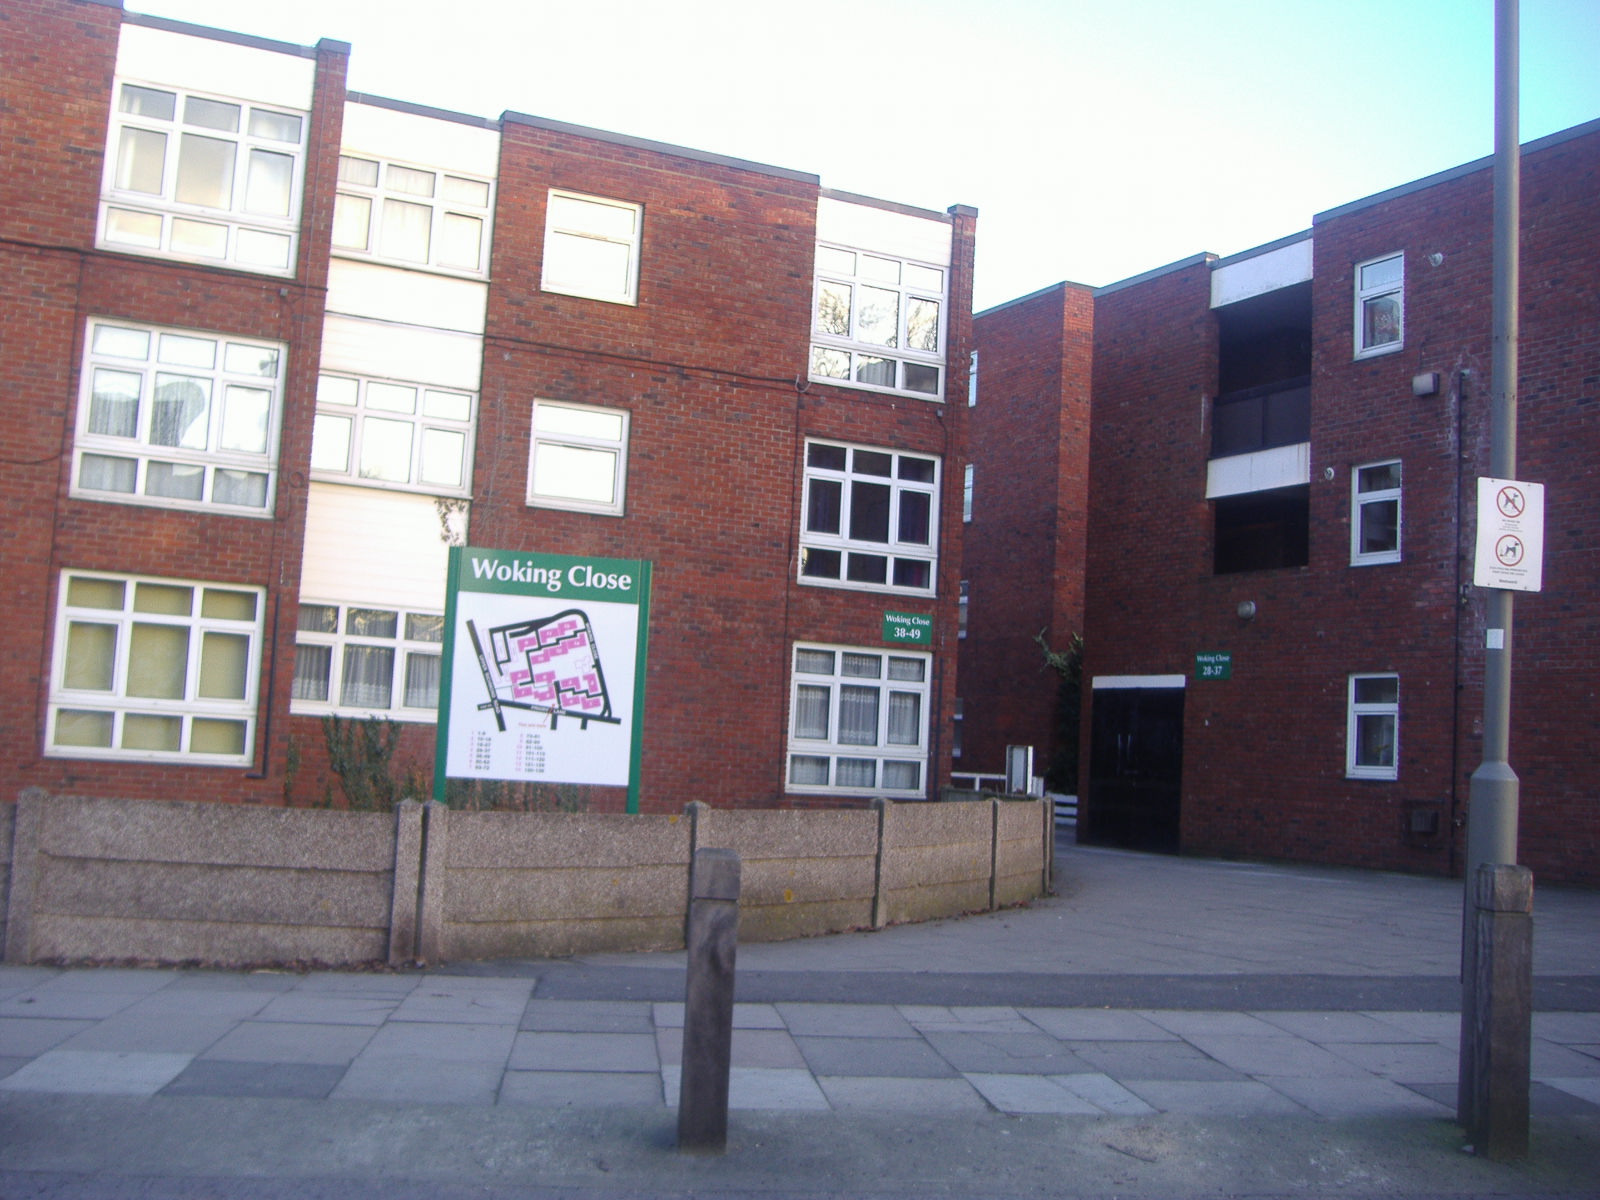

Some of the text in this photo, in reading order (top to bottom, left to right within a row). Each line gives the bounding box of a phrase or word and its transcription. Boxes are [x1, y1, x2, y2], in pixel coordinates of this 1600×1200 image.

[471, 557, 632, 592] Woking Close
[885, 614, 930, 626] Woking Close
[893, 626, 921, 639] 38-49
[1202, 665, 1223, 676] 28-37
